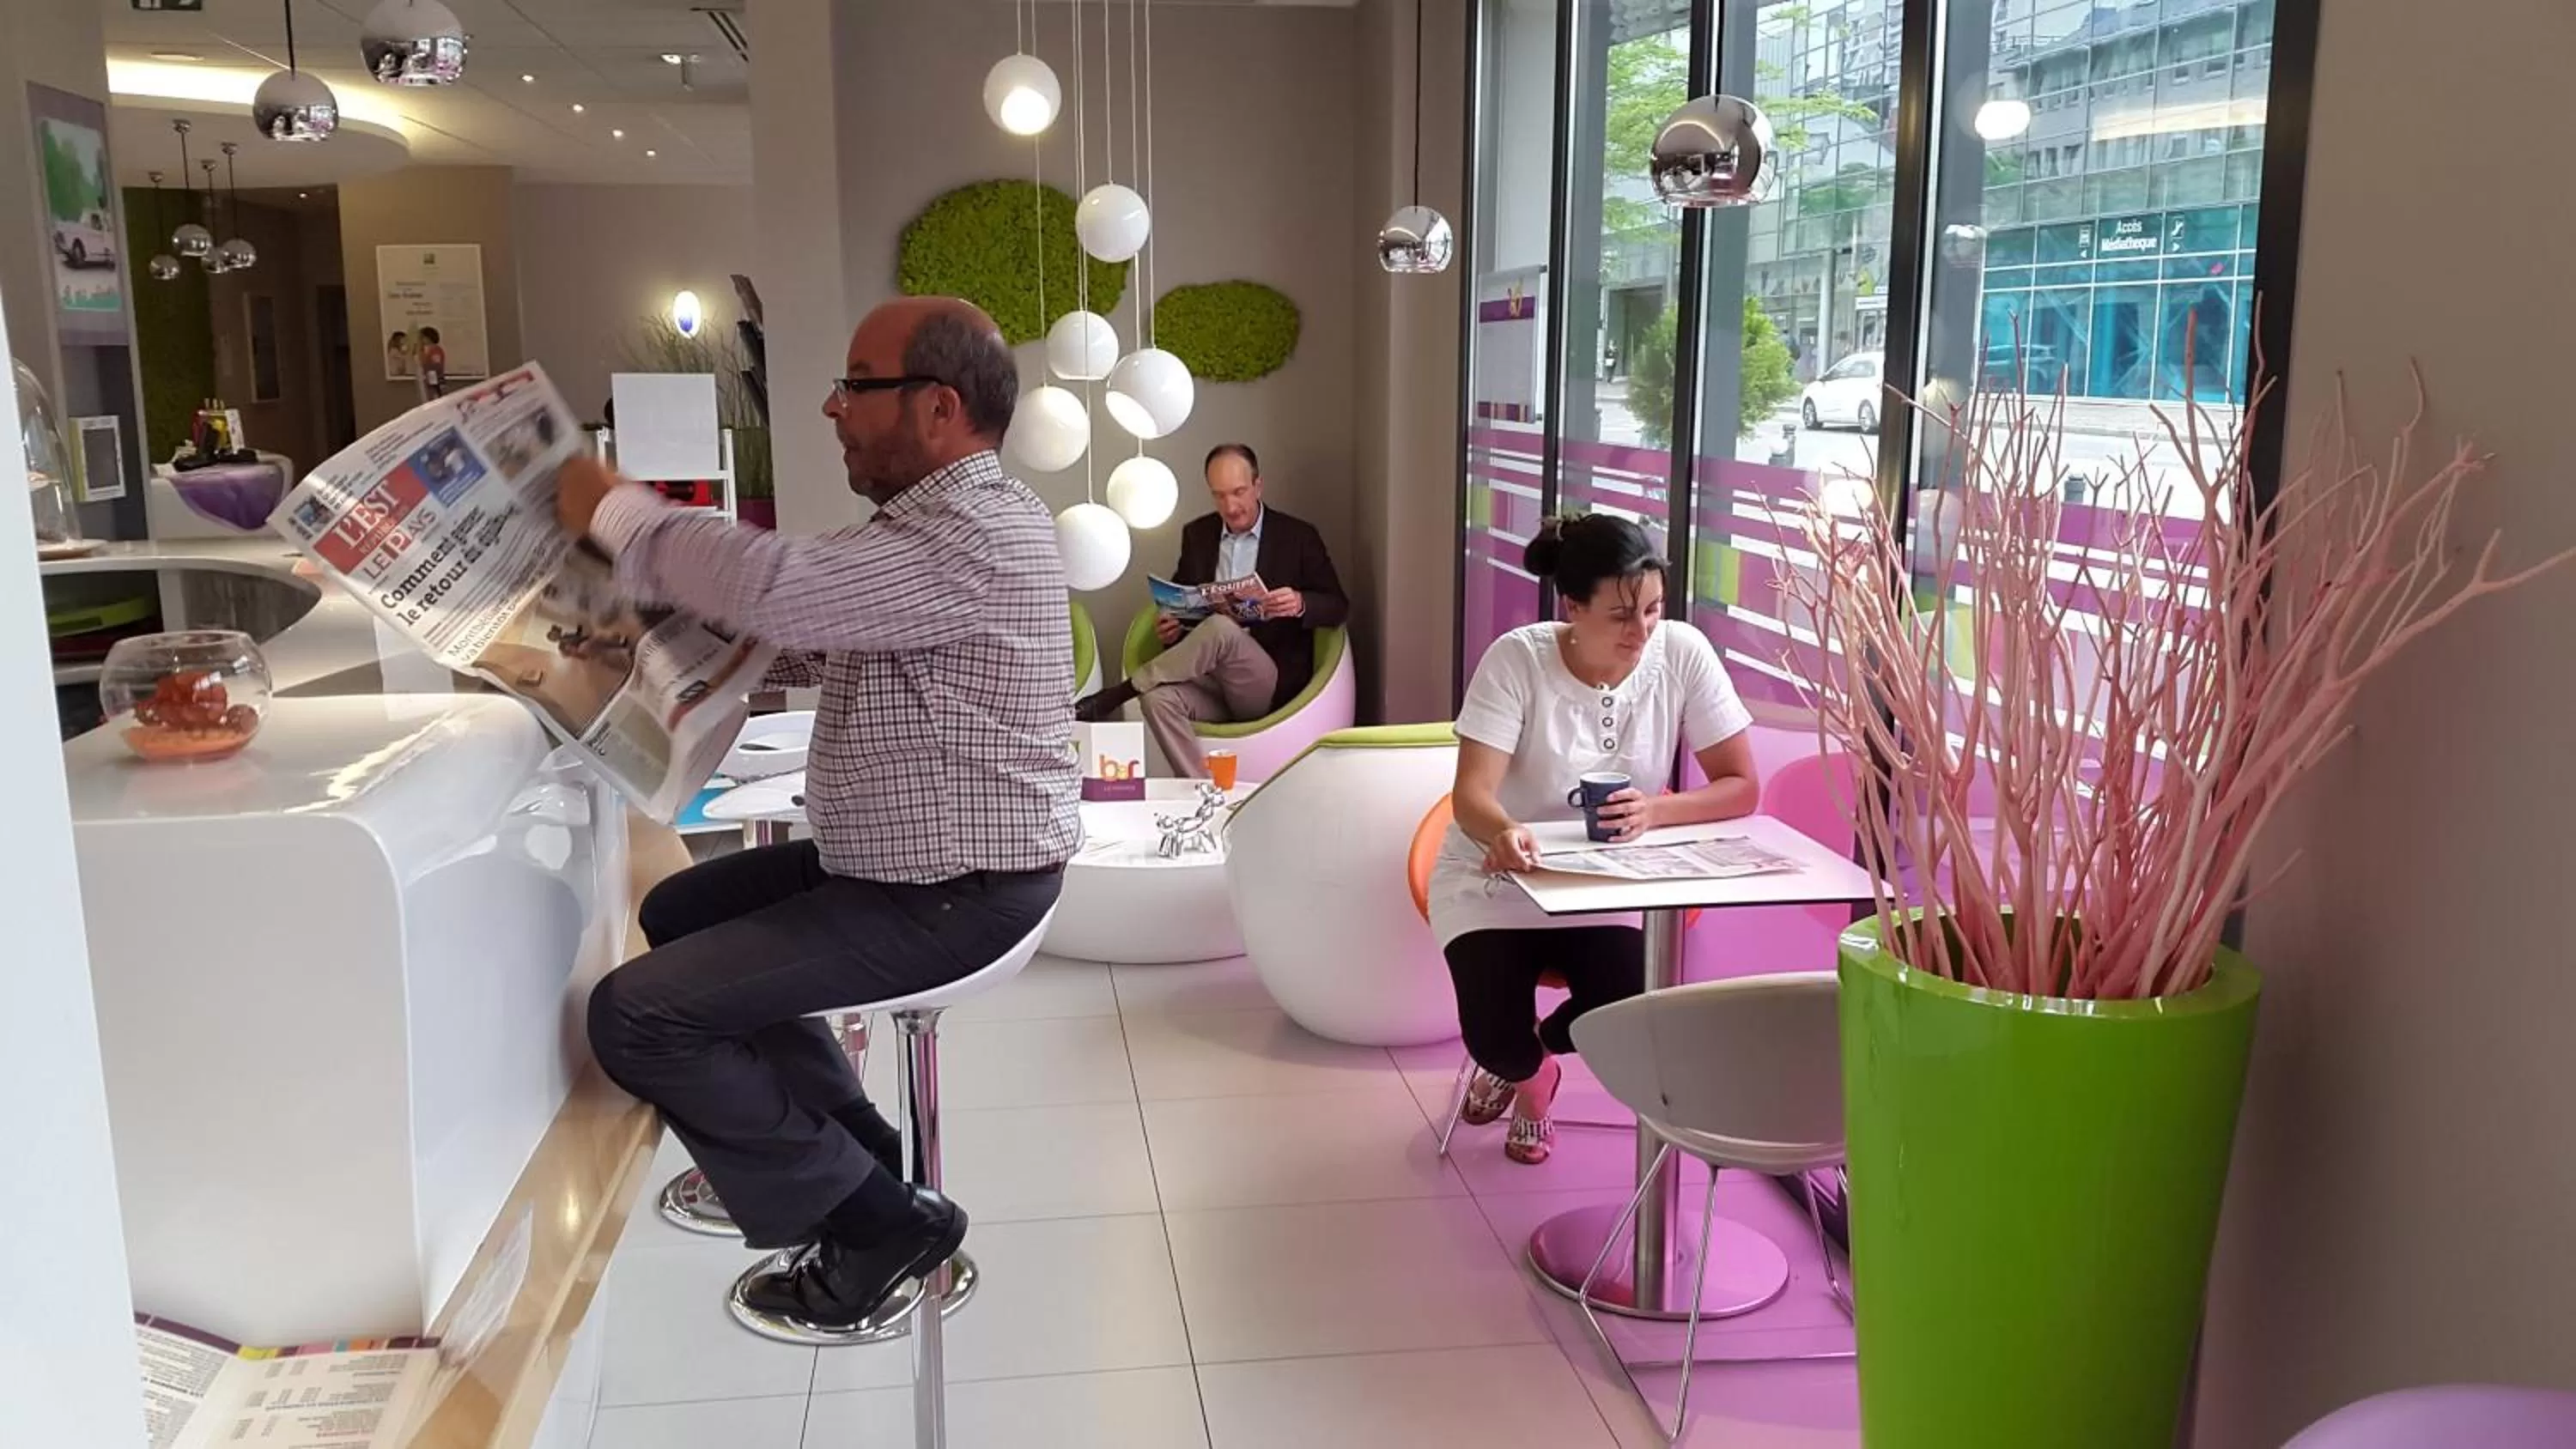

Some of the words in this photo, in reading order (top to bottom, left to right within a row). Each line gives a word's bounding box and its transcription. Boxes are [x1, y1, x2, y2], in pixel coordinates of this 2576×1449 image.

[2115, 218, 2142, 234] Accès
[331, 480, 400, 550] L'EST
[363, 553, 392, 579] LE
[380, 537, 456, 609] Comment
[397, 608, 422, 627] le
[416, 560, 468, 612] retour
